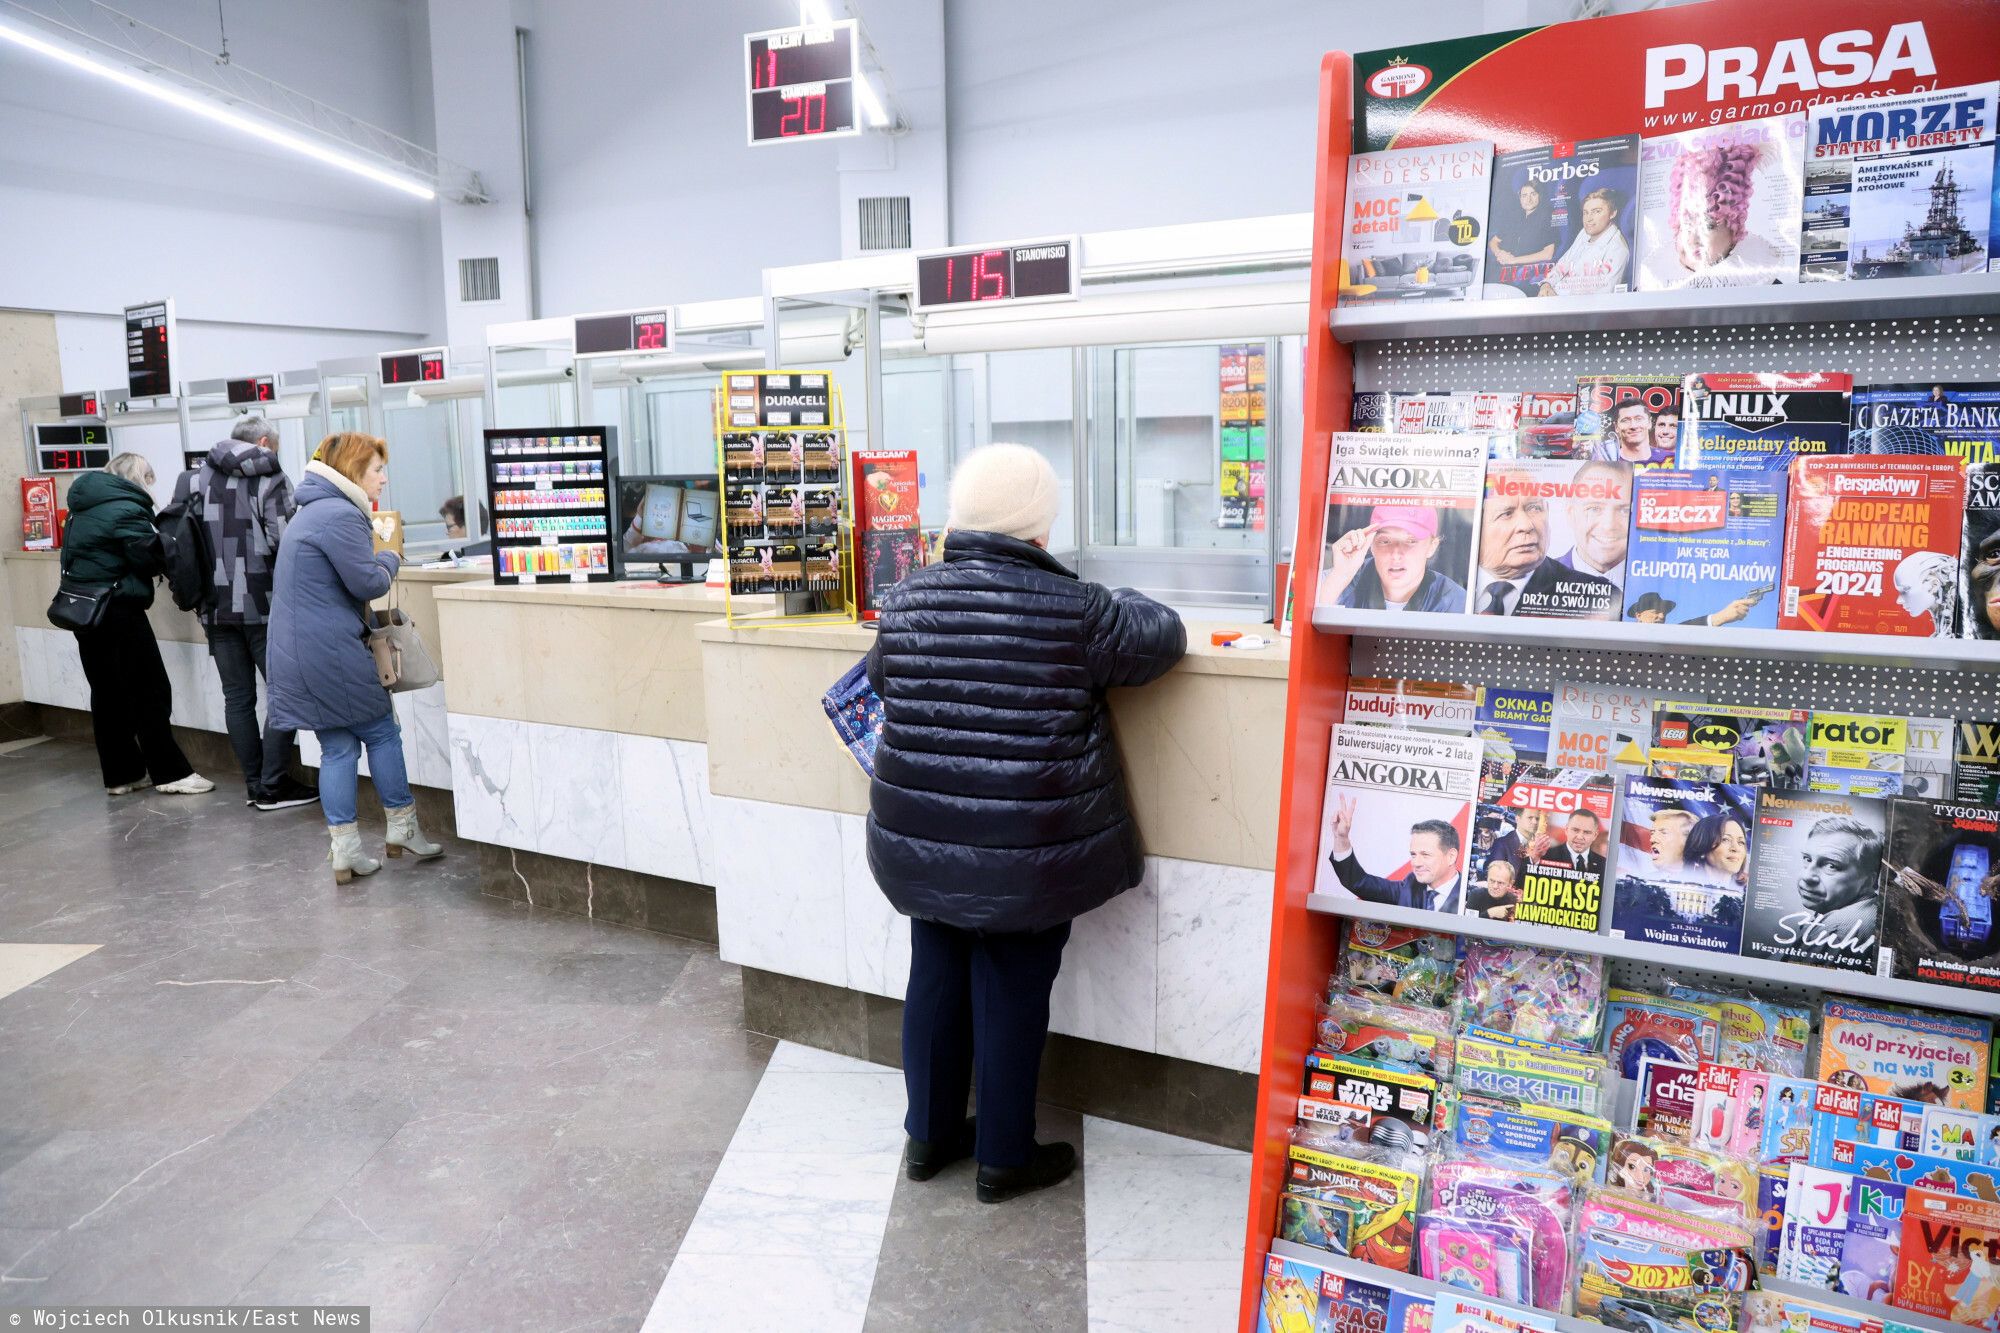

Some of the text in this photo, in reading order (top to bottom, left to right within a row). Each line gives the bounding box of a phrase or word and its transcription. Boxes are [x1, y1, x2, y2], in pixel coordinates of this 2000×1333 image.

[1645, 20, 1937, 109] PRASA
[780, 95, 826, 136] 20
[1818, 98, 1985, 146] MORZE
[1815, 131, 1984, 158] STATKI I OKRĘTY
[1356, 150, 1484, 174] DECORATION
[1384, 159, 1484, 184] DESIGN
[1858, 159, 1934, 174] AMERYKAŃSKIE
[1526, 160, 1600, 184] Forbes
[1858, 172, 1920, 188] KRĄŻOWNIKI
[1353, 197, 1400, 220] MOC
[1352, 217, 1399, 235] detali
[1016, 246, 1066, 262] STANOWISKO
[637, 324, 664, 350] 22
[424, 360, 443, 381] 21
[765, 394, 826, 407] DURACELL
[1874, 404, 1940, 428] GAZETA
[86, 431, 95, 445] 2
[1788, 436, 1827, 453] dom
[859, 451, 909, 459] POLECAMY
[1336, 441, 1480, 460] Iga Świątek niewinna?
[1840, 463, 1879, 471] UNIVERSITIES
[1932, 464, 1955, 472] EUROPE
[1331, 465, 1447, 490] ANGORA
[1489, 473, 1622, 500] Newsweek
[1834, 473, 1920, 497] Perspektywy
[1346, 495, 1456, 508] MAM ZŁAMANE SERCE
[1640, 497, 1657, 507] DO
[871, 514, 913, 523] MAGICZNY
[1639, 505, 1722, 524] RZECZY
[1817, 523, 1929, 548] RANKING
[1676, 546, 1730, 560] JAK SIĘ GRA
[1826, 546, 1902, 560] ENGINEERING
[1631, 560, 1776, 583] GŁUPOTĄ POLAKÓW
[1816, 559, 1884, 573] PROGRAMS
[1556, 581, 1612, 596] KACZYŃSKI
[1815, 572, 1883, 597] 2024
[1522, 591, 1611, 609] DRŻY O SWÓJ LOS
[1494, 696, 1538, 713] OKNA
[1494, 710, 1529, 720] BRAMY
[1558, 731, 1609, 754] MOC
[1662, 727, 1688, 740] LEGO
[1812, 721, 1895, 746] rator
[1337, 735, 1474, 761] Bulwersujący wyrok 2 lata
[1556, 752, 1608, 771] detali
[1333, 759, 1444, 791] ANGORA
[1511, 786, 1584, 812] SIECI
[1630, 781, 1716, 803] Newsweek
[1761, 793, 1853, 816] Newsweek
[1526, 864, 1583, 880] TAK SYSTEM TUSKA
[1523, 875, 1600, 912] DOPAŚĆ
[1515, 902, 1598, 931] NAWROCKIEGO
[1671, 922, 1703, 934] 5.11.2024
[1644, 928, 1729, 950] Wojna światów
[1751, 941, 1862, 967] Wszystkie role jego
[1918, 957, 1967, 972] Jak władza
[1917, 967, 1964, 985] POLSKIE
[1833, 1005, 1842, 1016] 2
[1624, 1007, 1696, 1034] KACZOR
[1472, 1028, 1516, 1045] WYDANIE
[1839, 1031, 1971, 1066] Mój przyjaciel
[1331, 1063, 1422, 1086] ZABAWKA LEGO SZTURMOWY
[1873, 1060, 1935, 1078] na wsi
[1311, 1079, 1334, 1092] LEGO
[1338, 1078, 1393, 1101] STAR
[1470, 1068, 1580, 1109] KICK-IT!
[1338, 1089, 1393, 1112] WARS
[1833, 1091, 1859, 1111] Fakt
[1315, 1113, 1341, 1123] WARS
[1316, 1107, 1341, 1117] STAR
[1873, 1102, 1901, 1124] Fakt
[1497, 1122, 1547, 1136] WALKIE-TALKIE
[1505, 1131, 1544, 1143] SPORTOWY
[1505, 1139, 1537, 1149] ZEGAREK
[1833, 1147, 1853, 1163] Fakt
[1310, 1168, 1397, 1200] NINJAGO KOMIKS
[1460, 1195, 1499, 1217] PONY
[1467, 1190, 1493, 1203] LITTLE
[1956, 1202, 1970, 1212] DO
[1803, 1233, 1831, 1246] TO BĘDĄ
[1807, 1228, 1831, 1237] SPECJALNE
[1815, 1243, 1839, 1256] ŚWIĘTA!
[1268, 1261, 1283, 1274] Fakt
[1906, 1260, 1936, 1288] BY
[1322, 1273, 1343, 1294] Fakt
[1901, 1285, 1943, 1305] ŚWIĘTA
[1455, 1303, 1481, 1316] Nasza
[1897, 1297, 1947, 1316] były magiczne
